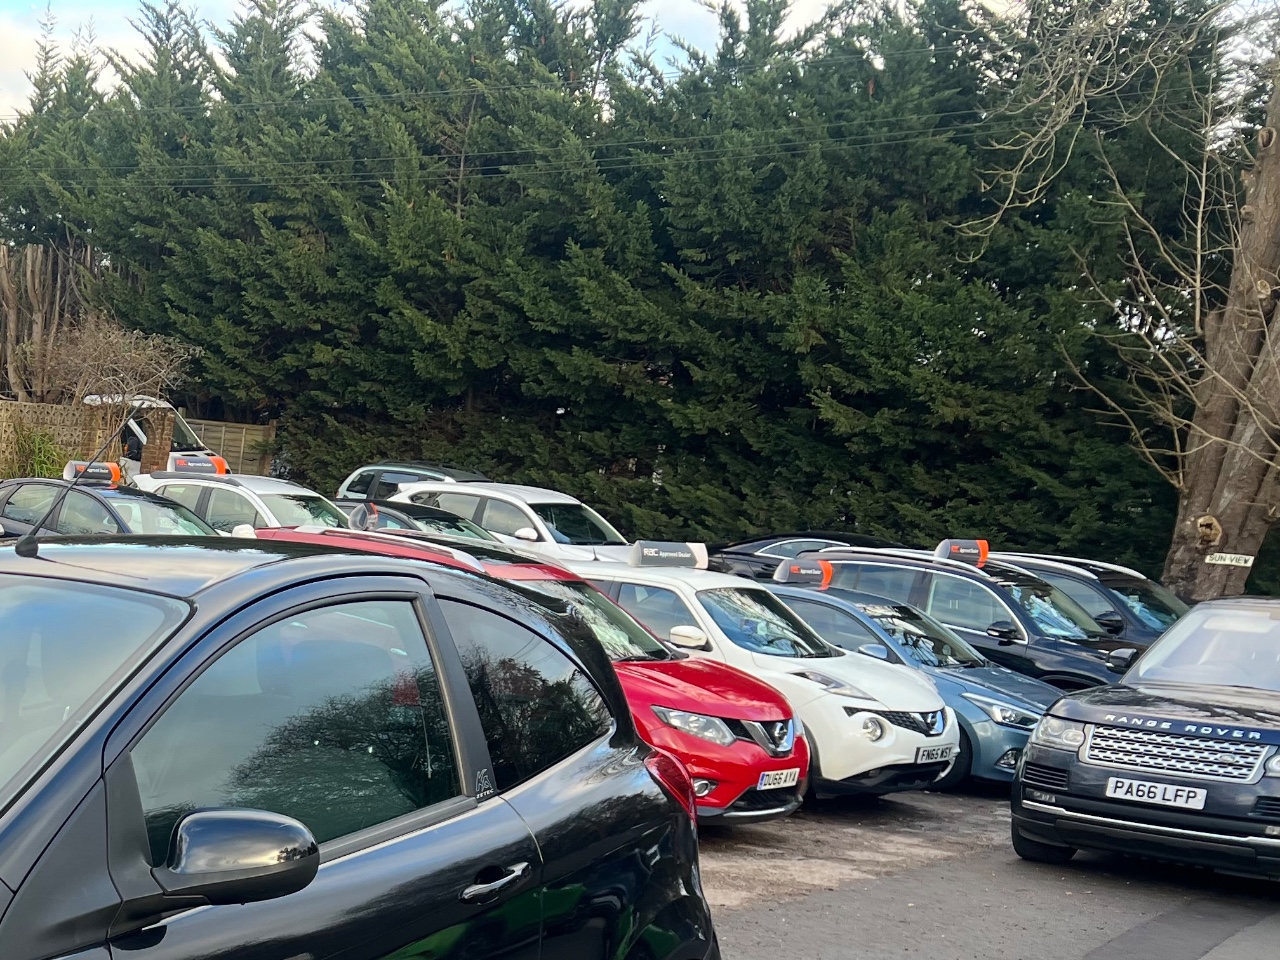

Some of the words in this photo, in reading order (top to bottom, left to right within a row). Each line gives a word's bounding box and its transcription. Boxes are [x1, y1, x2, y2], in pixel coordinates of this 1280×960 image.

[1209, 554, 1227, 562] SUN
[1230, 555, 1250, 565] VIEW
[1105, 714, 1173, 730] RANGE
[1185, 724, 1263, 741] ROVER
[1113, 780, 1157, 799] PA66
[1162, 786, 1198, 804] LFP
